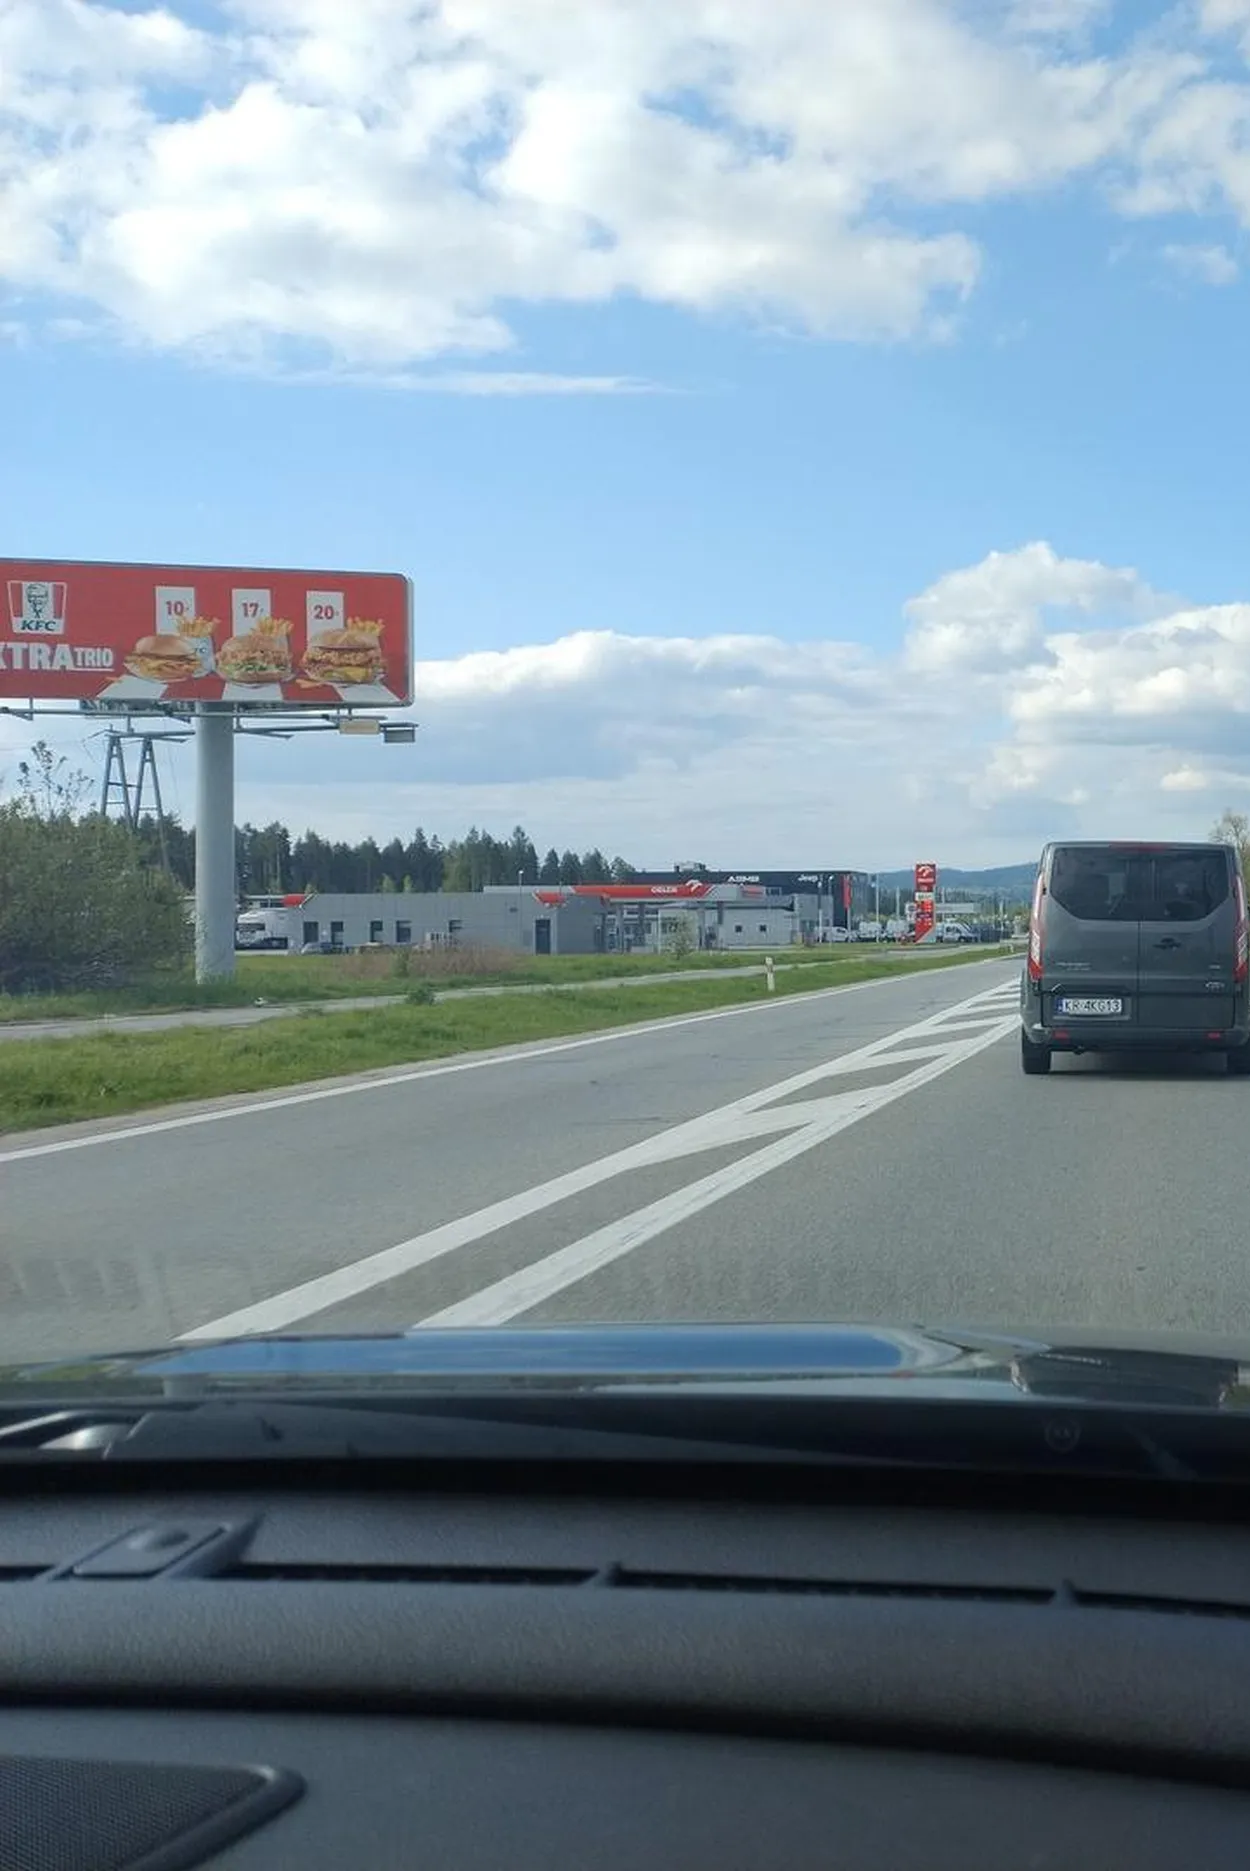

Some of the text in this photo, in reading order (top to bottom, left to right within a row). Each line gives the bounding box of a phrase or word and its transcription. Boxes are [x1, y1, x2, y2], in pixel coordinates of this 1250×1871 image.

[165, 600, 185, 616] 10
[242, 602, 260, 618] 17
[313, 604, 335, 620] 20
[21, 620, 57, 632] KFC
